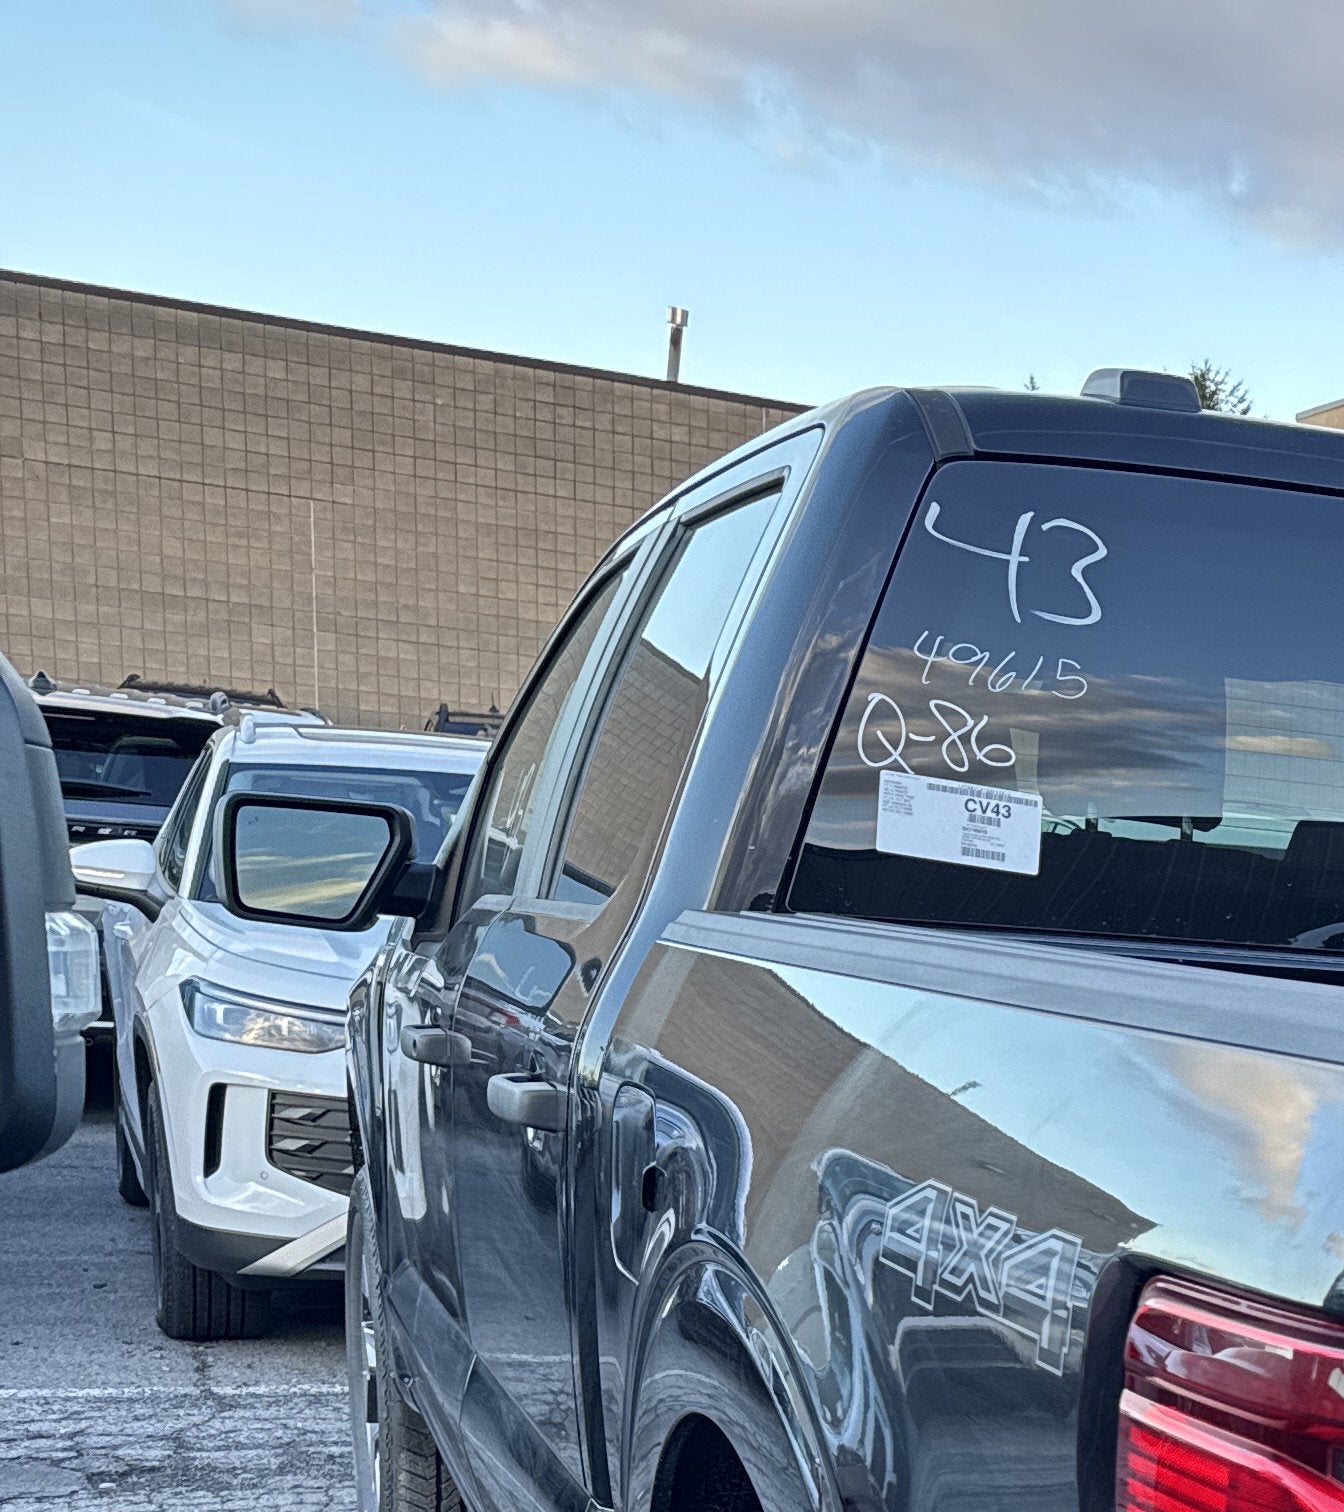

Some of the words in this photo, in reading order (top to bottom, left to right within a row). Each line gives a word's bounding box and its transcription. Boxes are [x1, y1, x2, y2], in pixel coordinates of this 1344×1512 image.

[924, 501, 1108, 626] 43
[913, 630, 1088, 700] 49615
[857, 692, 1017, 774] Q-86
[964, 798, 1012, 820] CV43
